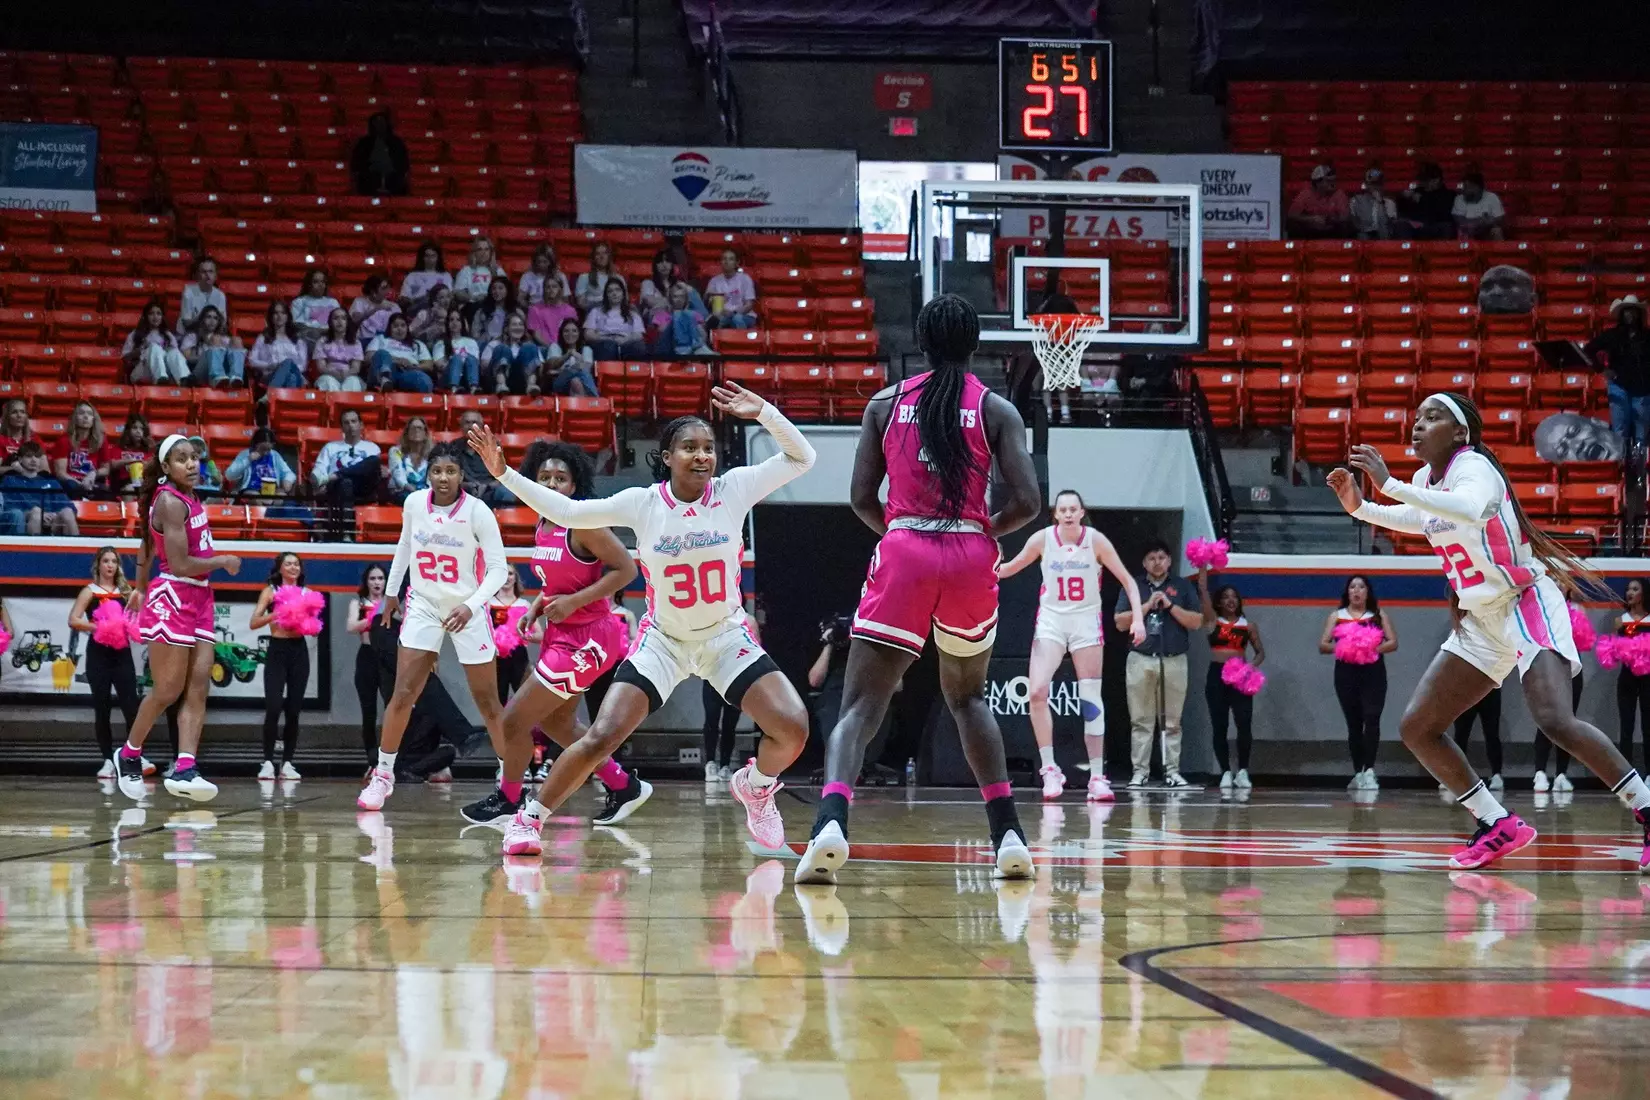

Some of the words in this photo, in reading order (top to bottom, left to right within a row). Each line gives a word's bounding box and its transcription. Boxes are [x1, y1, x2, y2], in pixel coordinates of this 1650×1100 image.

[1024, 84, 1087, 137] 27
[714, 165, 755, 181] Prime
[1200, 169, 1236, 182] EVERY
[1029, 215, 1144, 238] PZZAS
[653, 536, 683, 557] Lady
[683, 531, 729, 551] Techsters
[416, 551, 459, 583] 23
[664, 559, 726, 609] 30
[1057, 576, 1085, 601] 18
